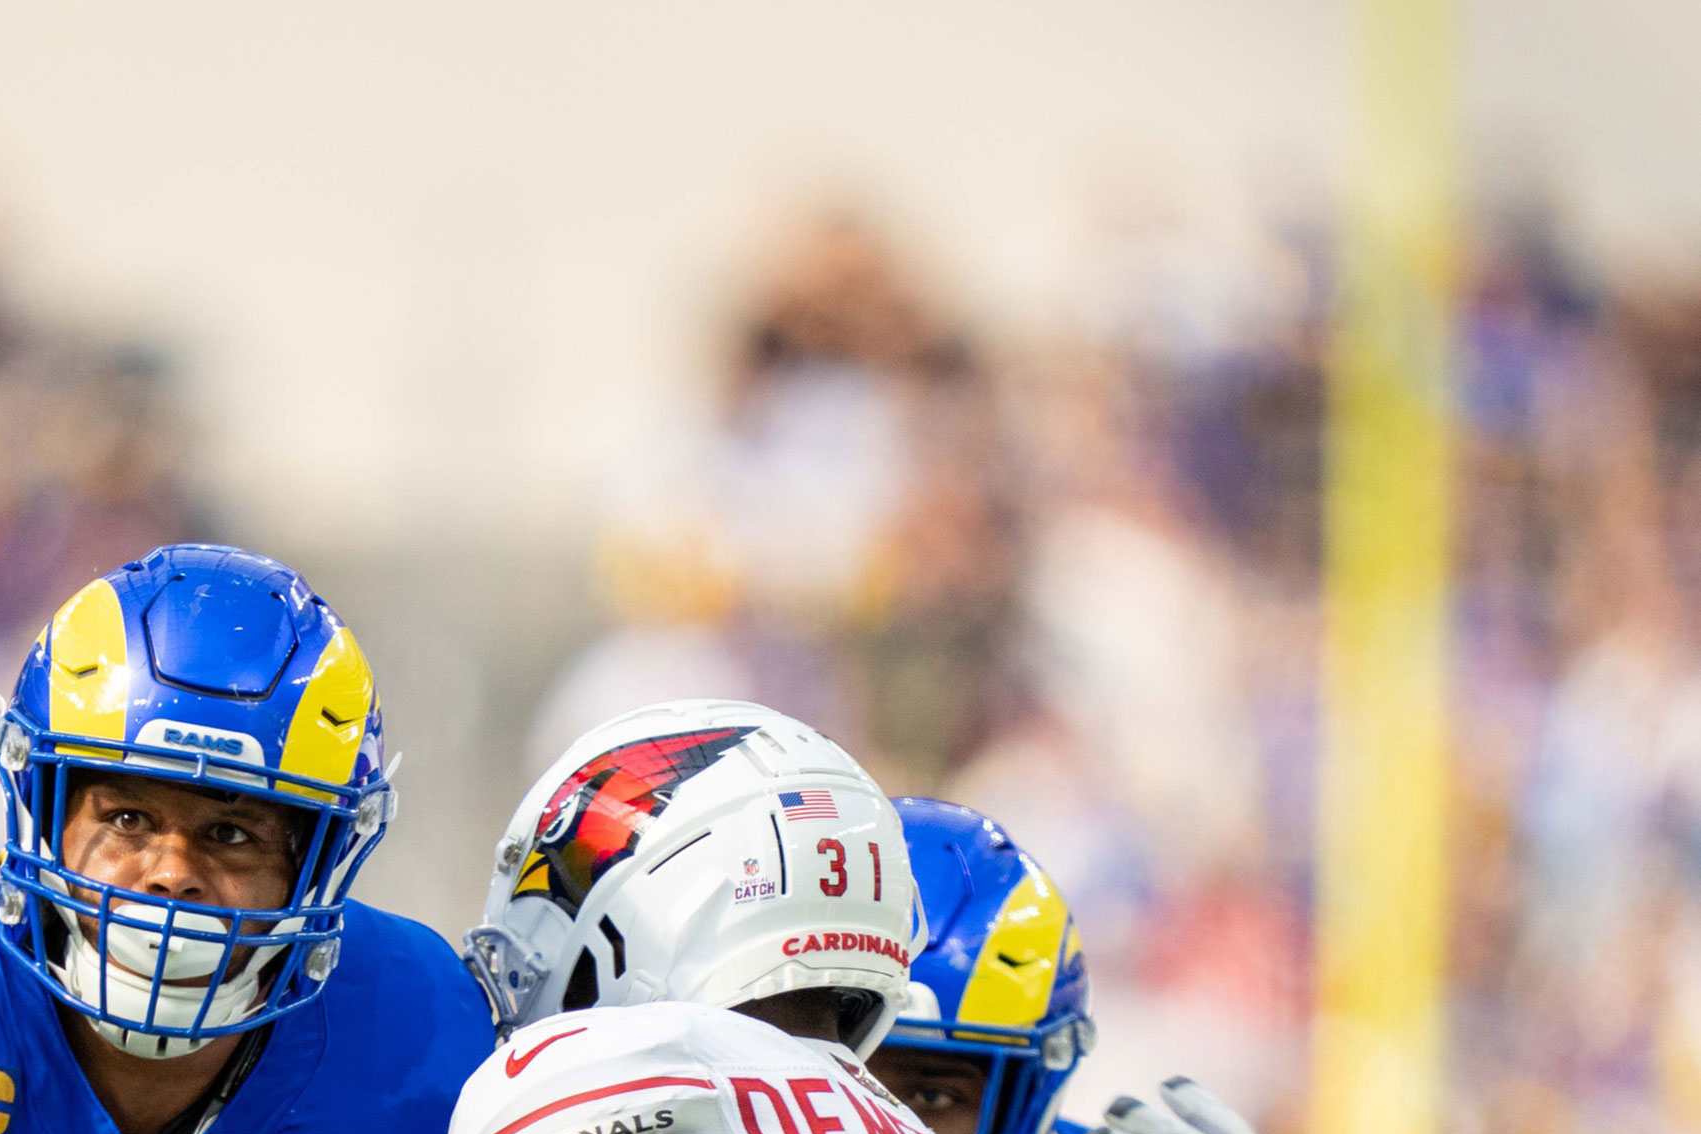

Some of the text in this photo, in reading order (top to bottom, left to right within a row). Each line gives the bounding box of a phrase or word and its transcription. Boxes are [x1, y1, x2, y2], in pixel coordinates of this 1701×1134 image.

[163, 728, 244, 756] RAMS
[816, 837, 881, 902] 31
[735, 881, 775, 900] CATCH
[782, 932, 909, 968] CARDINALS
